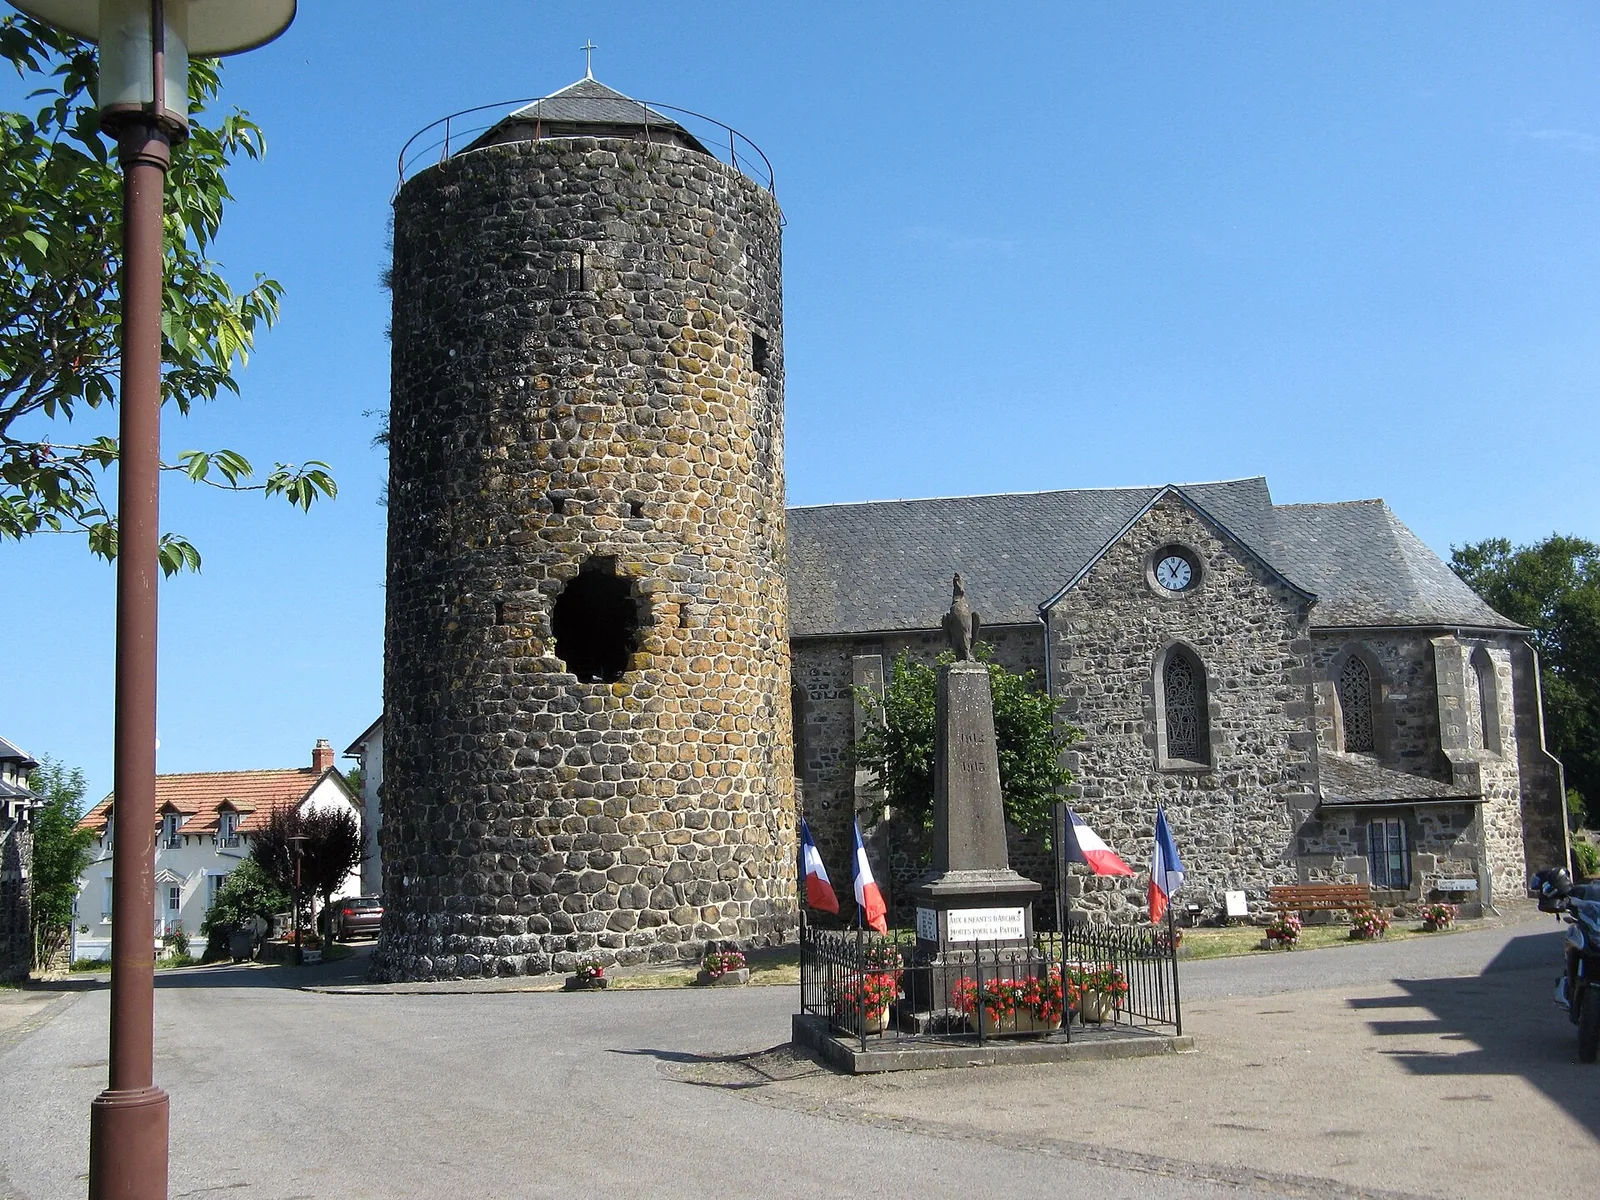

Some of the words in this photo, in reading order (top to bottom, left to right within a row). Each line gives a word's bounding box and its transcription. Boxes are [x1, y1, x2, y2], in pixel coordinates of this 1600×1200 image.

[949, 916, 962, 924] AUX
[963, 915, 992, 923] ENFANTS
[950, 928, 972, 936] MORTS
[972, 928, 989, 936] POUR
[999, 926, 1021, 934] PATRIE
